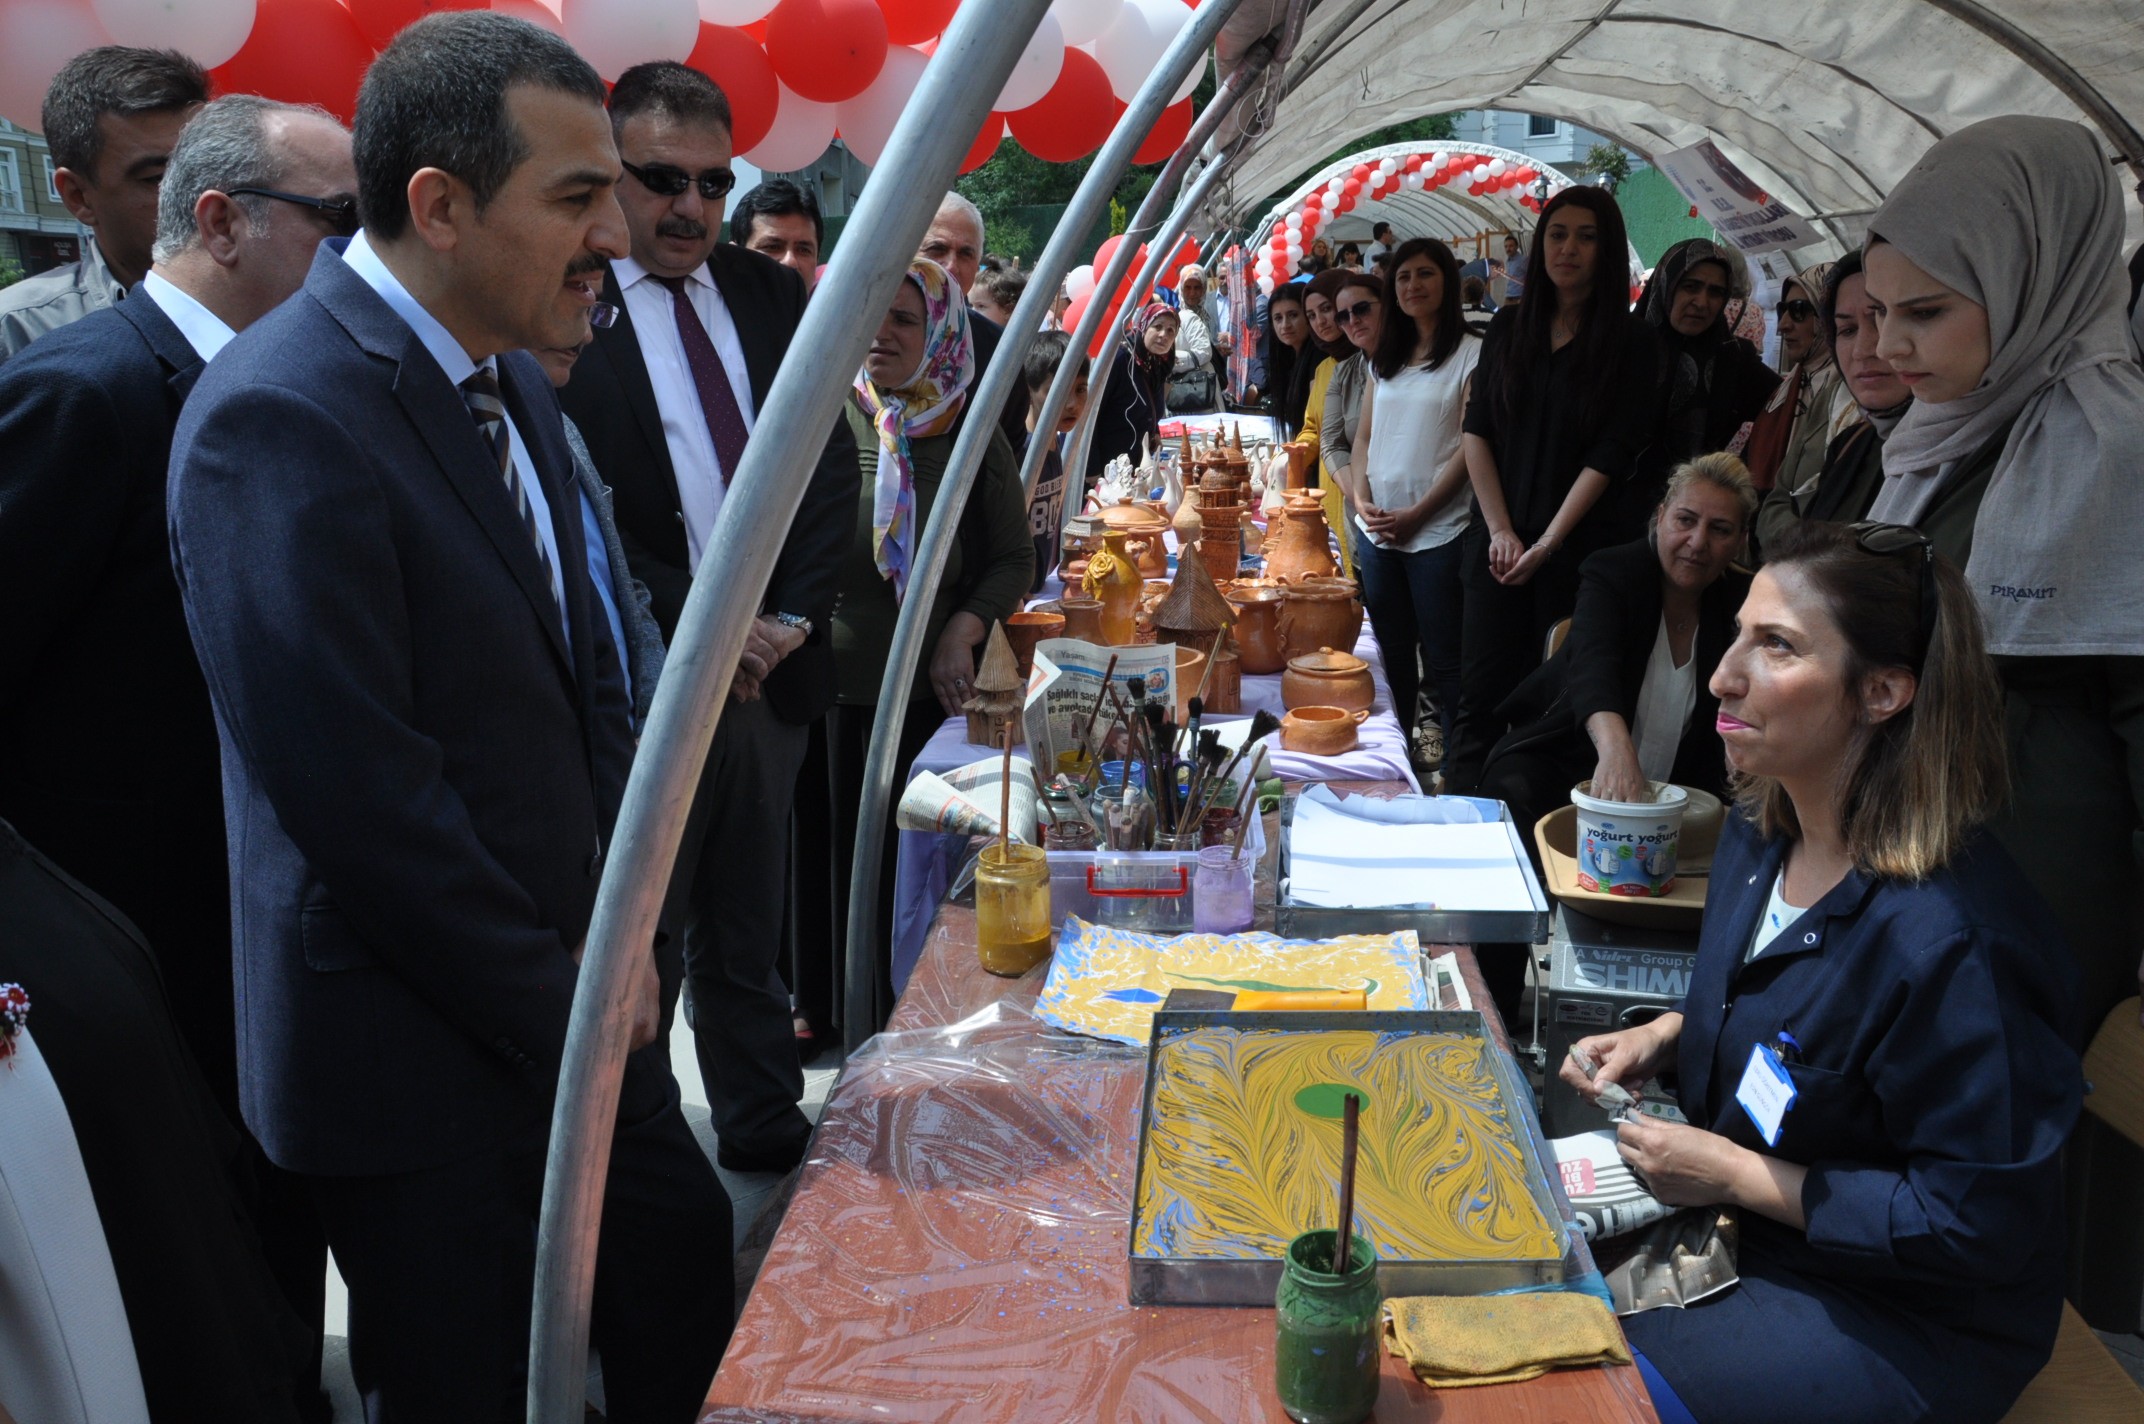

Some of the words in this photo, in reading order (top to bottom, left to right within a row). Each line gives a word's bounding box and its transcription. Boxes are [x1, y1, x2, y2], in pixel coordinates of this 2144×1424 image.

[1047, 688, 1078, 702] Sağlıklı
[1059, 702, 1095, 715] avokad
[1587, 827, 1633, 842] yoğurt
[1638, 830, 1678, 845] yoğurt
[1641, 953, 1683, 968] Group
